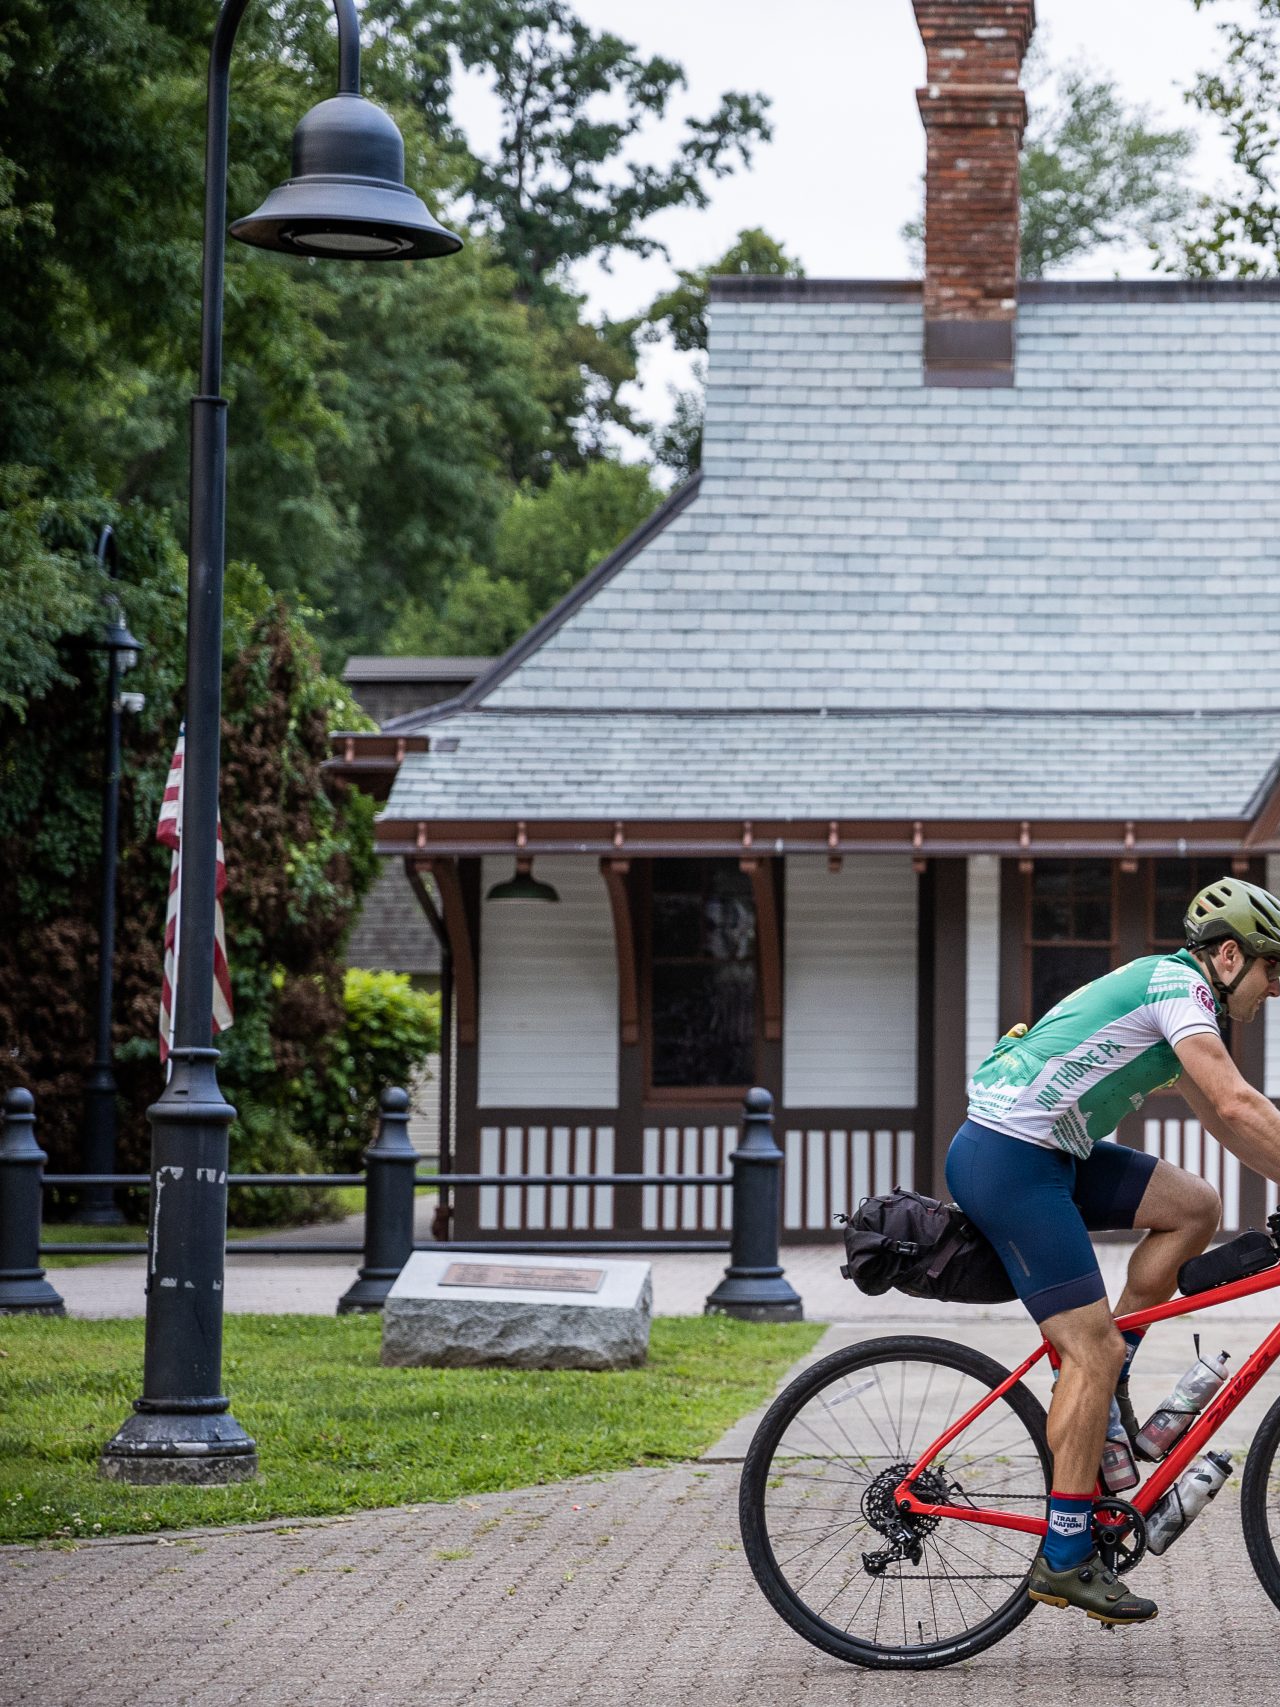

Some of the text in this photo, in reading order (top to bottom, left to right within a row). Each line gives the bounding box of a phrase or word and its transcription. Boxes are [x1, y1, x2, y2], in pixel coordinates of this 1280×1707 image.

[1035, 1084, 1063, 1112] JIM
[1056, 1515, 1078, 1523] TRAIL
[1053, 1520, 1083, 1529] NATION
